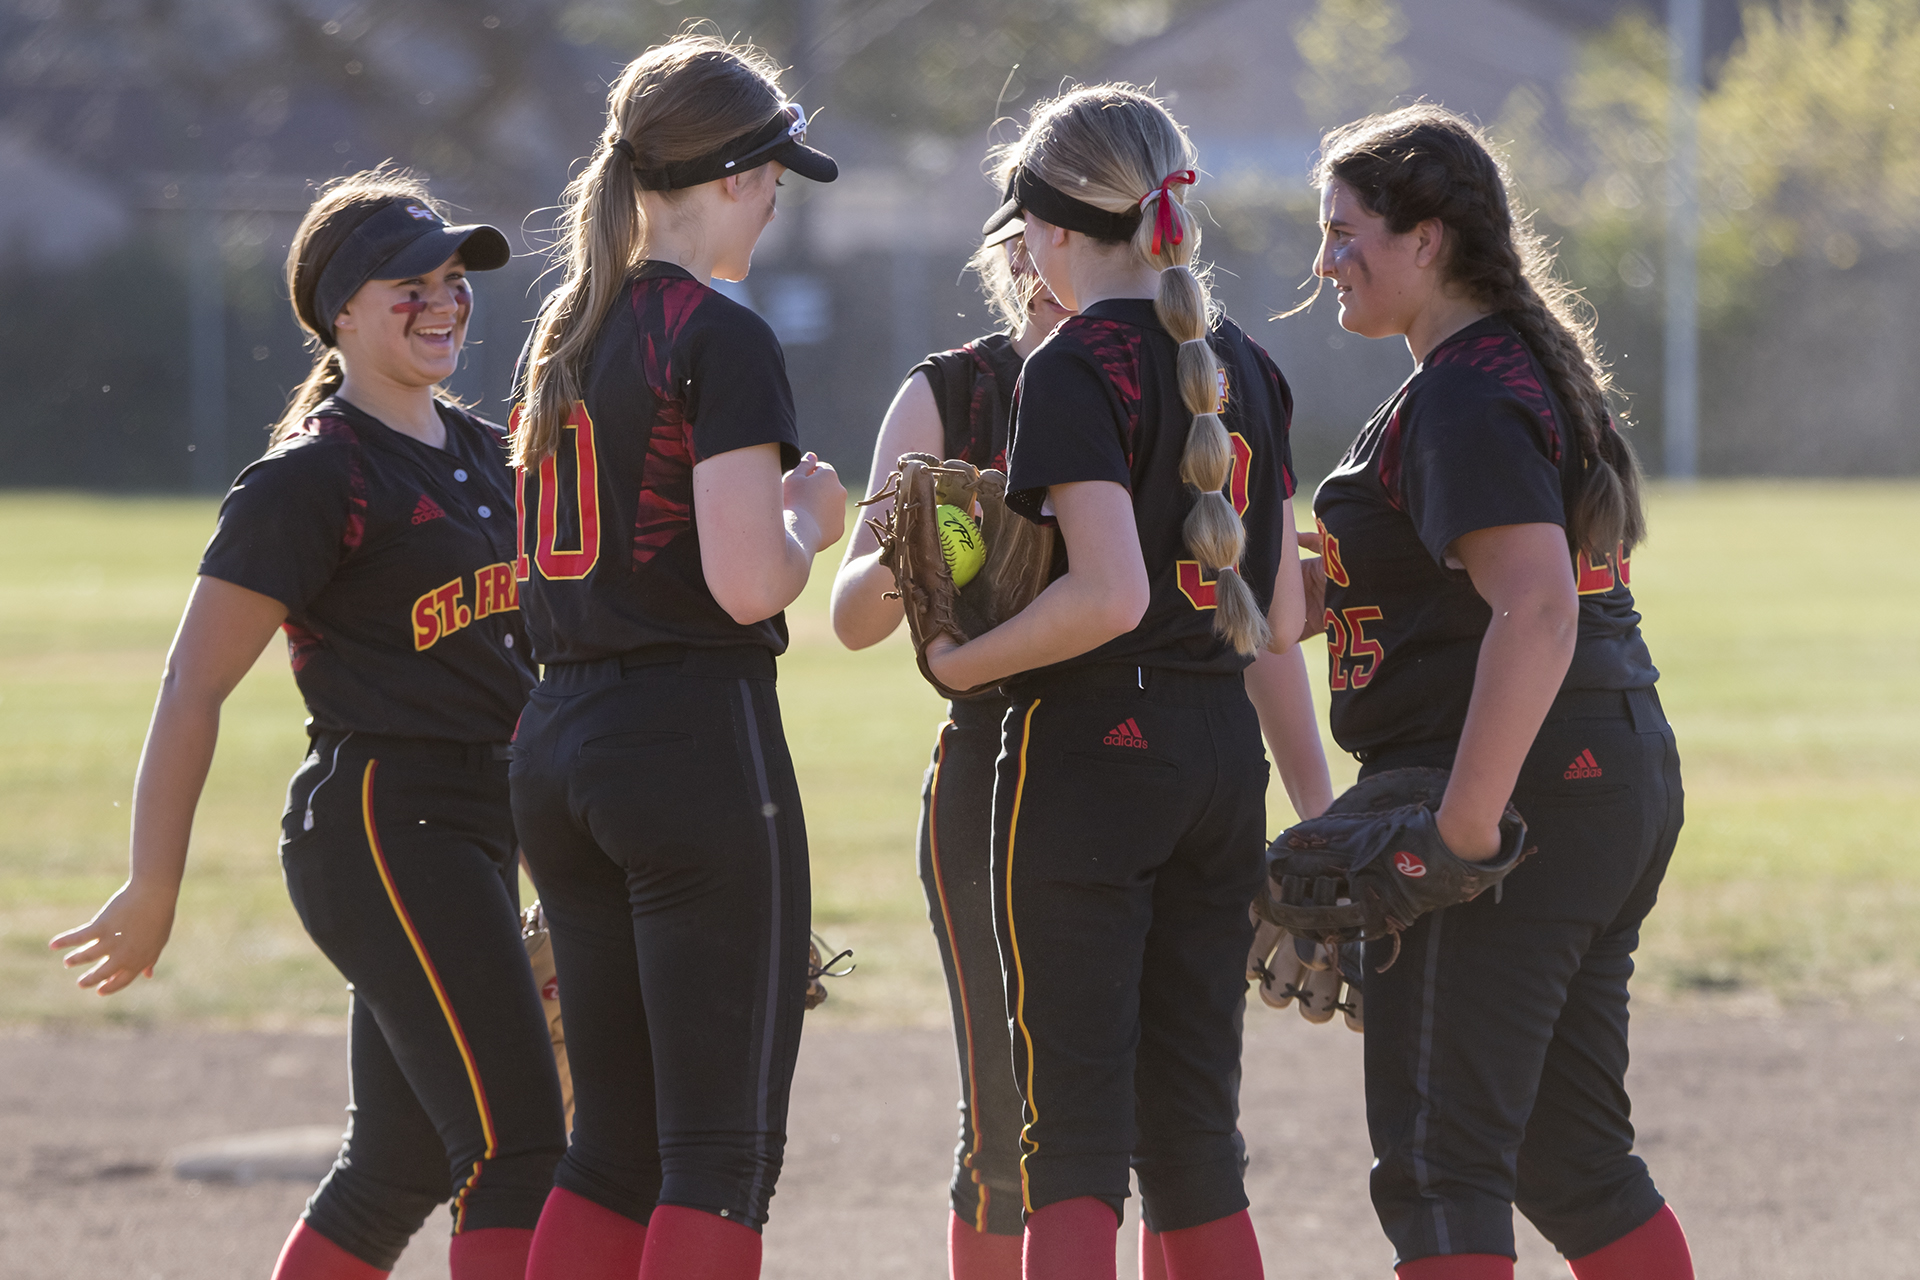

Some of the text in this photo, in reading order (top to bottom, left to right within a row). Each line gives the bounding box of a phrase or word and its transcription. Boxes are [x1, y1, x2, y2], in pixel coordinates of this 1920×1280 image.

[405, 205, 435, 221] SF
[411, 576, 471, 651] ST.
[1323, 605, 1384, 692] 25
[1102, 734, 1148, 750] adidas
[1563, 766, 1602, 780] adidas
